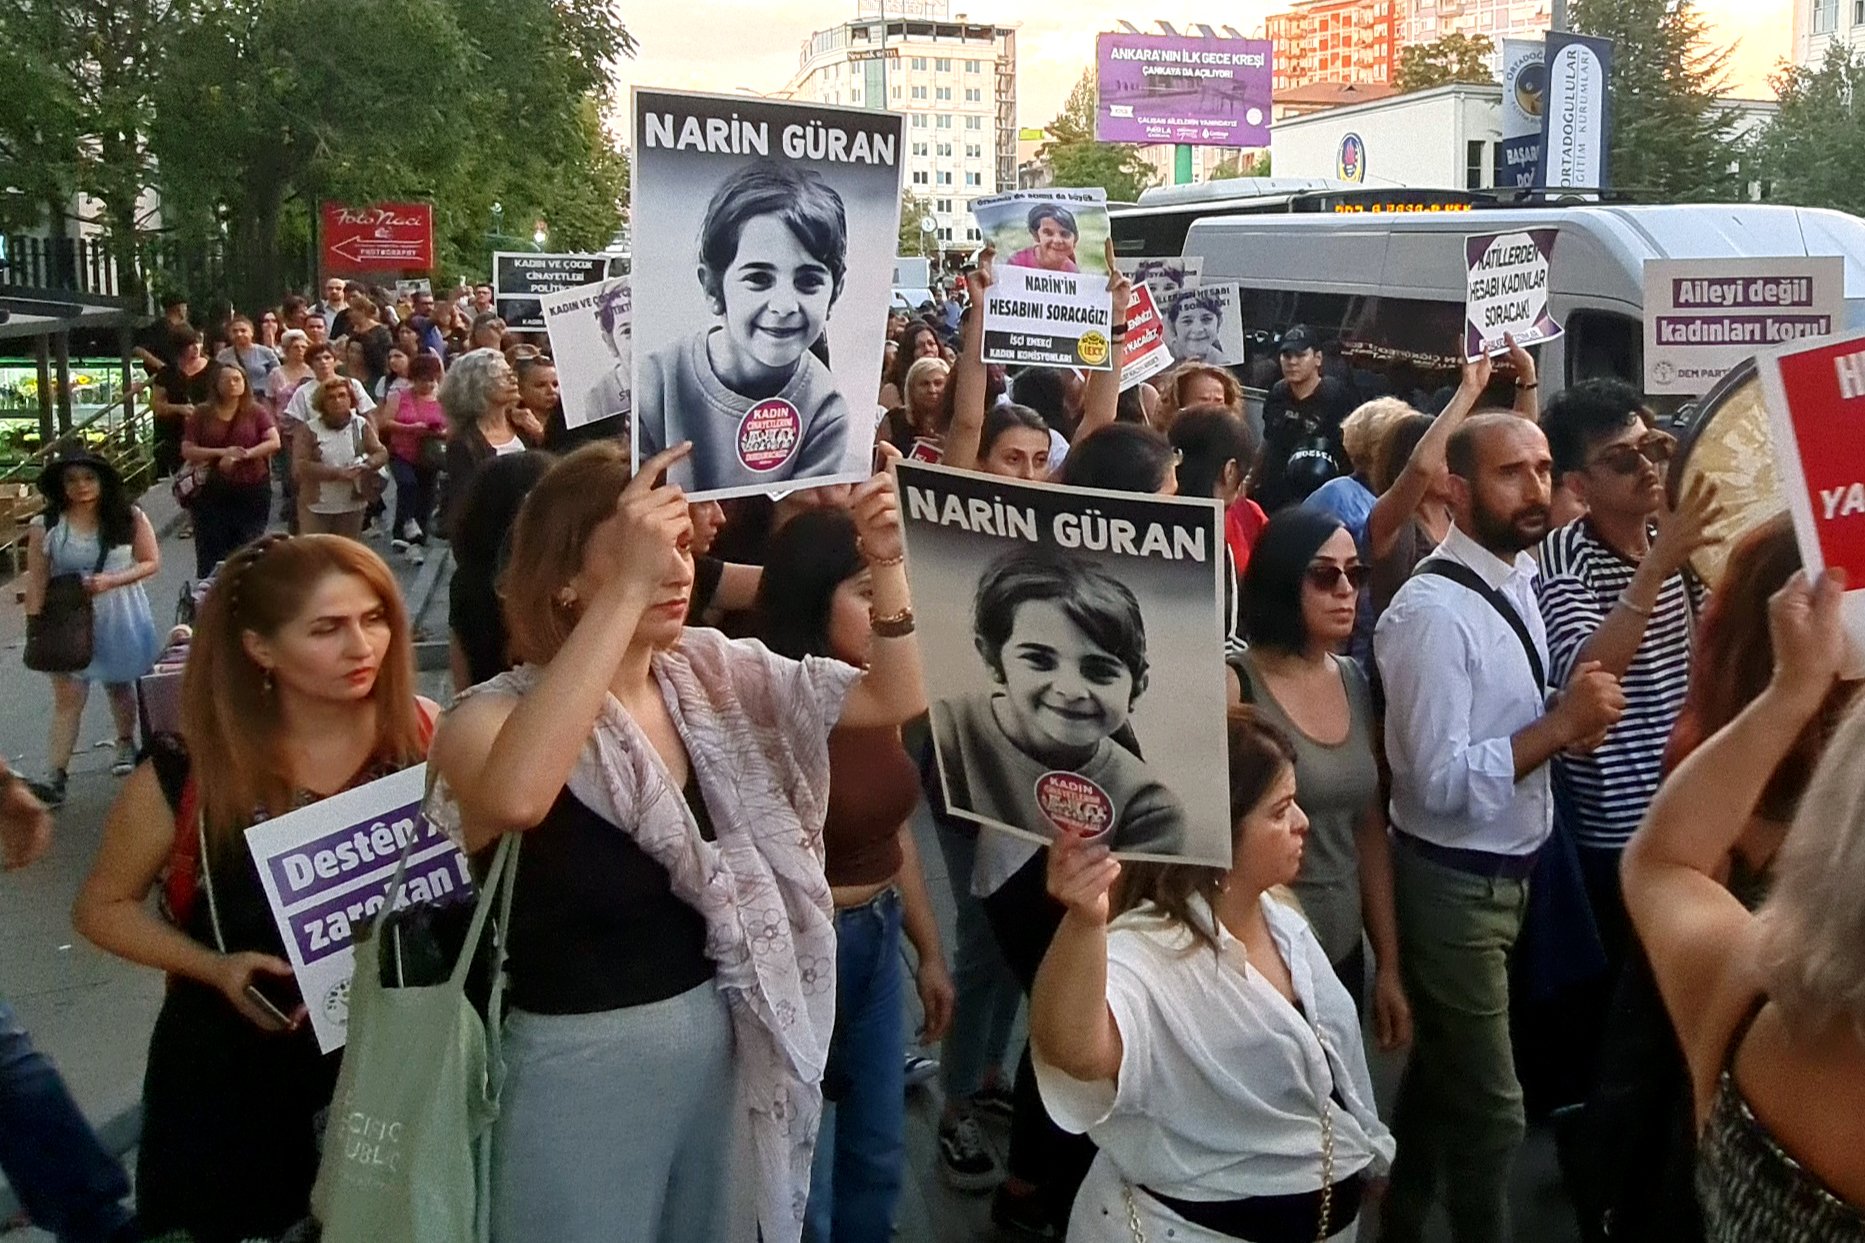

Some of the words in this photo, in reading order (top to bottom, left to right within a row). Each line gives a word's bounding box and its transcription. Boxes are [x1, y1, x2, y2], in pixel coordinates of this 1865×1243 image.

[1111, 47, 1181, 63] ANKARA'NIN
[1182, 48, 1200, 64] İLK
[1201, 52, 1231, 65] GECE
[1232, 52, 1265, 68] KREŞİ
[1578, 50, 1590, 133] KURUMLARI
[645, 112, 769, 156] NARİN
[782, 119, 895, 166] GÜRAN
[1506, 145, 1540, 168] BAŞAR
[1576, 143, 1587, 184] ĞİTİM
[514, 259, 546, 268] KADIN
[548, 260, 562, 268] VE
[563, 260, 593, 270] ÇOCUK
[1478, 243, 1539, 271] KATİLLERDEN
[526, 270, 584, 281] CİNAYETLERİ
[1025, 274, 1077, 296] NARİN'İN
[1469, 277, 1499, 302] HESABI
[1501, 269, 1546, 296] KADINLAR
[1678, 280, 1743, 306] Aileyi
[1748, 279, 1807, 305] değil
[549, 301, 580, 316] KADIN
[580, 297, 592, 308] VE
[989, 298, 1043, 319] HESABINI
[1046, 305, 1108, 326] SORACAĞIZ!
[1485, 297, 1531, 328] SORACAK!
[1660, 319, 1761, 342] kadınları
[1766, 318, 1827, 341] koru!
[990, 348, 1015, 359] KADIN
[1678, 368, 1699, 378] DEM
[1701, 367, 1731, 378] PART
[753, 407, 789, 419] KADIN
[907, 485, 1038, 542] NARİN
[1053, 509, 1206, 562] GÜRAN
[1049, 776, 1093, 795] KADIN
[282, 817, 418, 892] Destên
